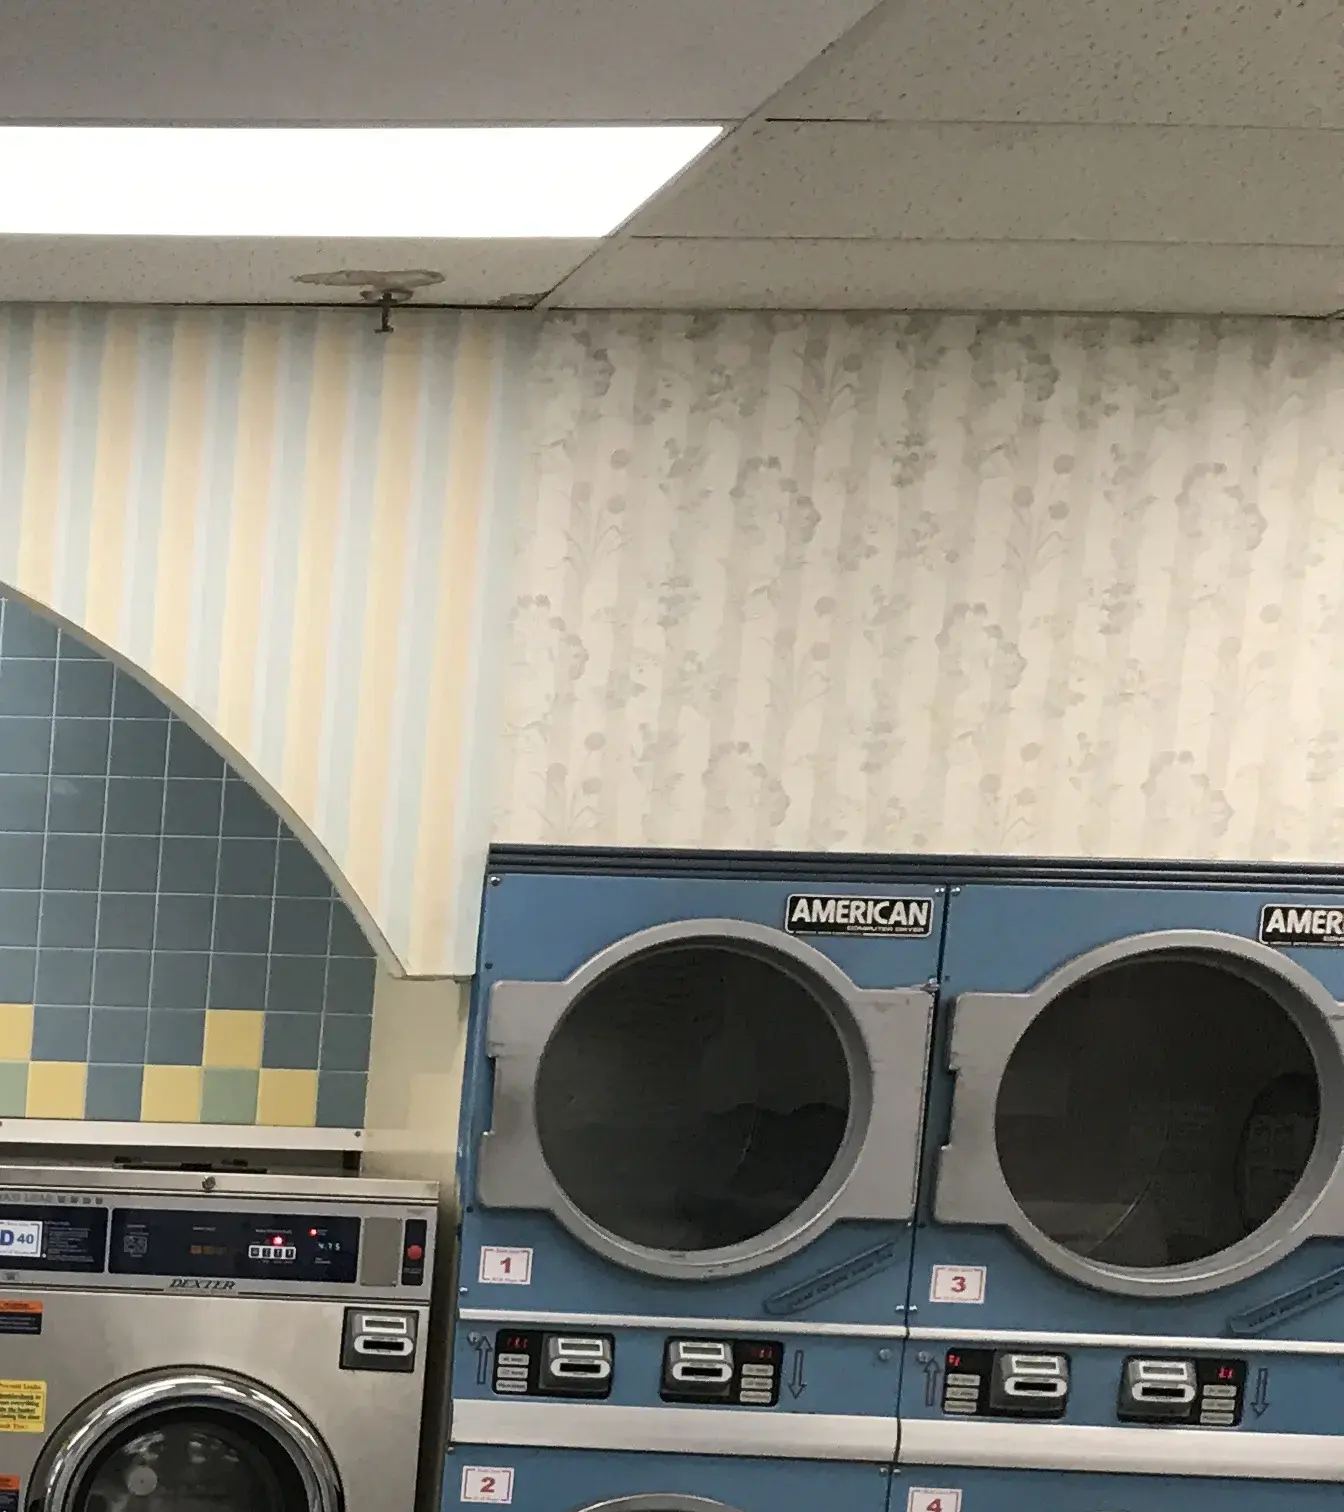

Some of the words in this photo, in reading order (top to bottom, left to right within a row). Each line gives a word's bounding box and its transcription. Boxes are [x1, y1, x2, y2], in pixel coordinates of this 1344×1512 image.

[791, 898, 929, 926] AMERICAN
[0, 1229, 14, 1246] D
[16, 1234, 34, 1244] 40
[500, 1257, 511, 1273] 1
[169, 1278, 236, 1290] DEXTER
[951, 1276, 966, 1292] 3
[480, 1476, 495, 1493] 2
